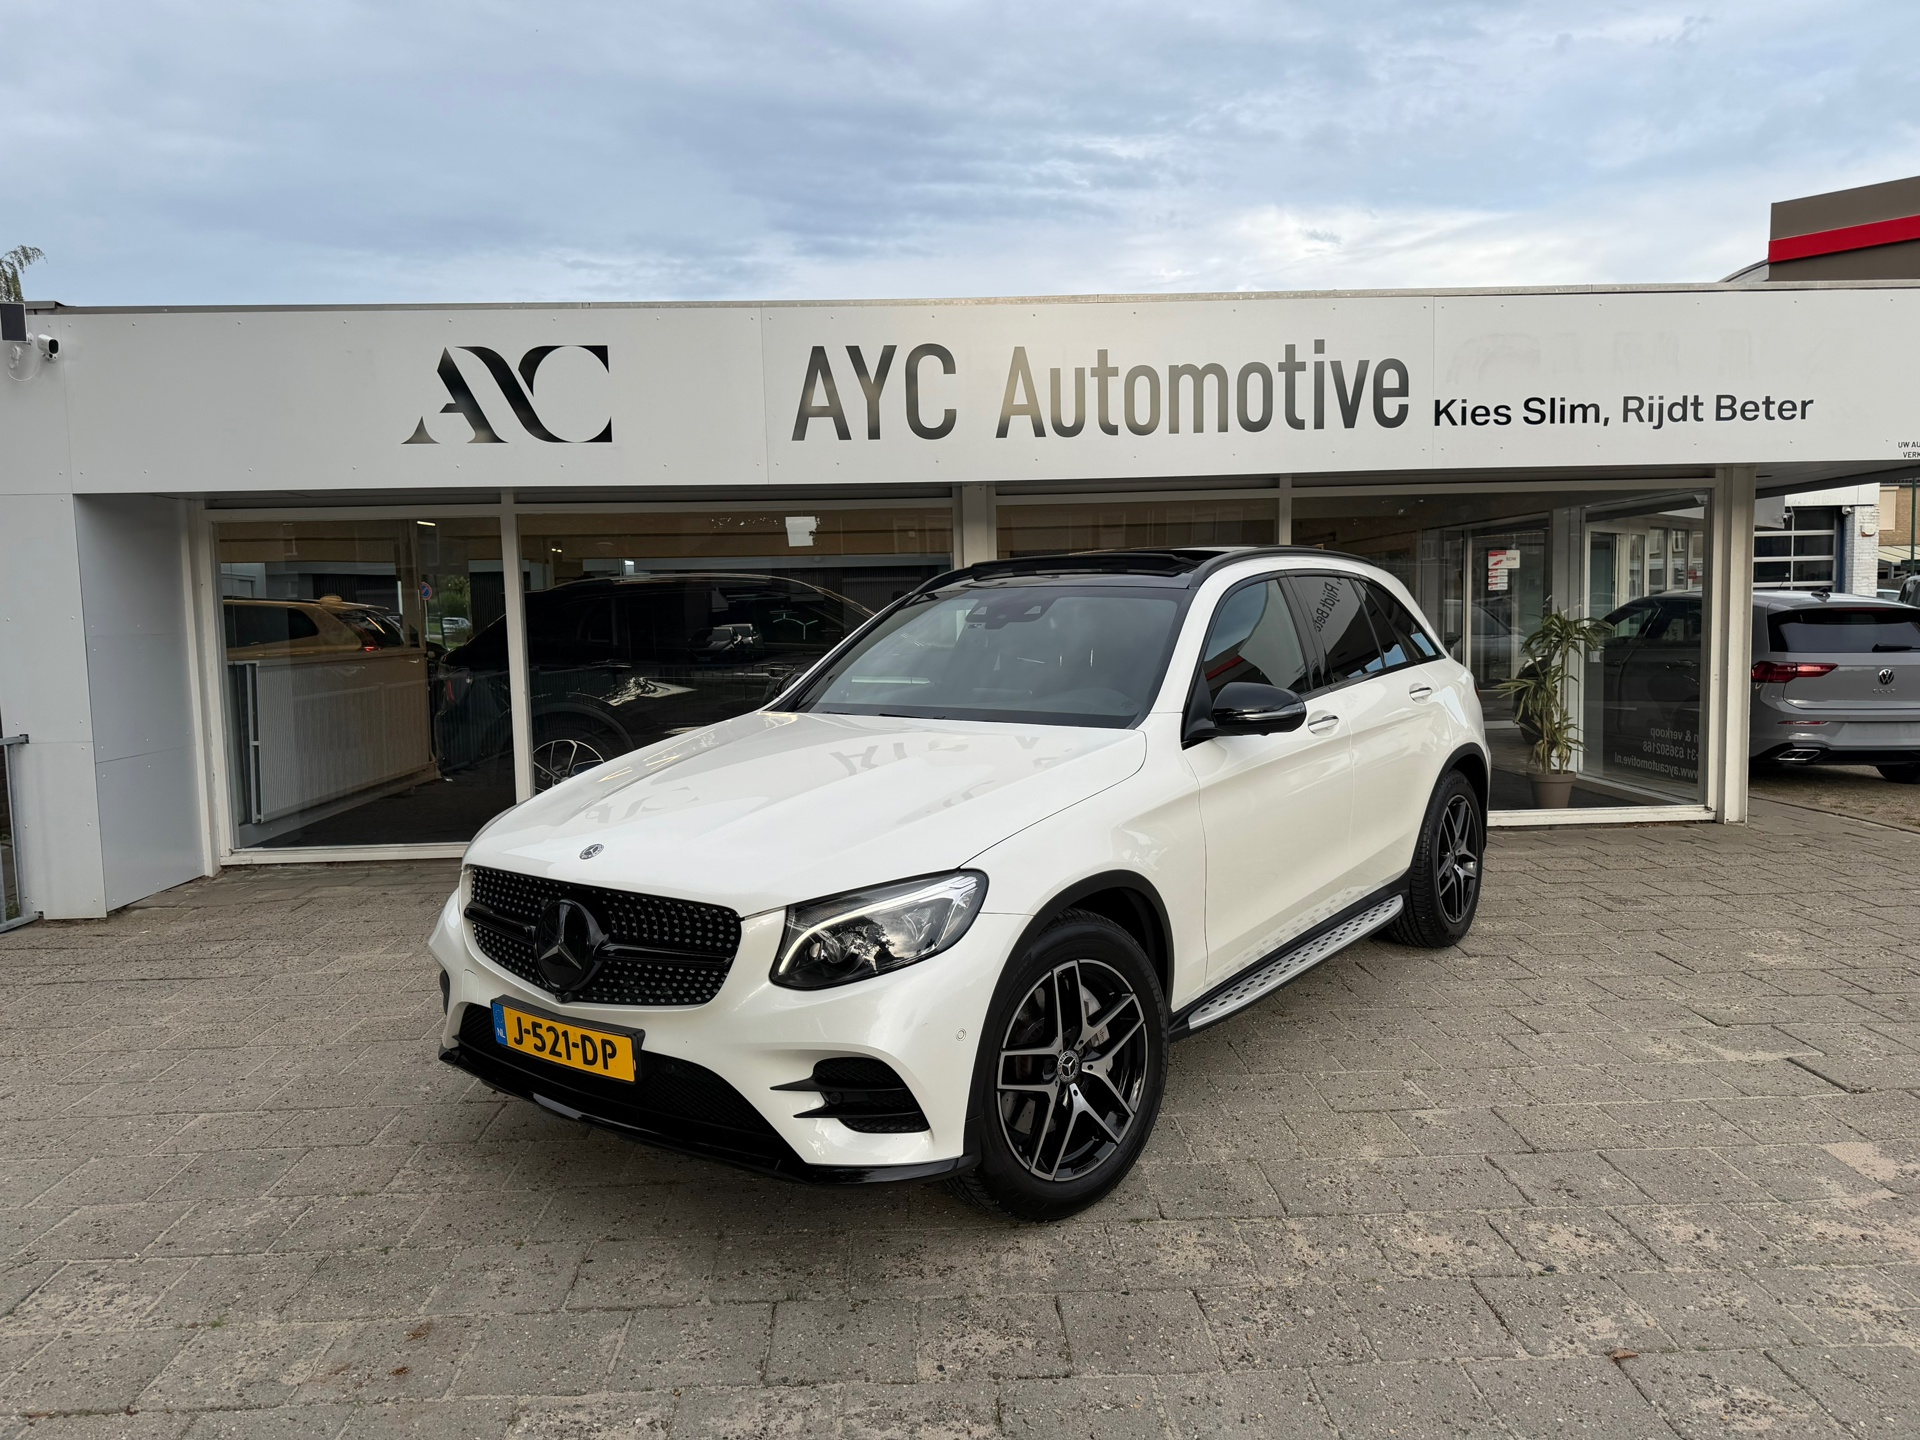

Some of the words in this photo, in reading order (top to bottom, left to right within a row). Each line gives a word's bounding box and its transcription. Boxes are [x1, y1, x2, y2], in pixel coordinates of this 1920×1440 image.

[792, 343, 957, 442] AYC
[996, 339, 1410, 438] Automotive
[1435, 399, 1512, 427] Kies
[1523, 396, 1610, 427] Slim,
[1623, 395, 1704, 430] Rijdt
[1716, 395, 1814, 422] Beter
[1897, 441, 1910, 449] UW
[497, 1027, 506, 1039] NL
[513, 1016, 617, 1070] J-521-DP
